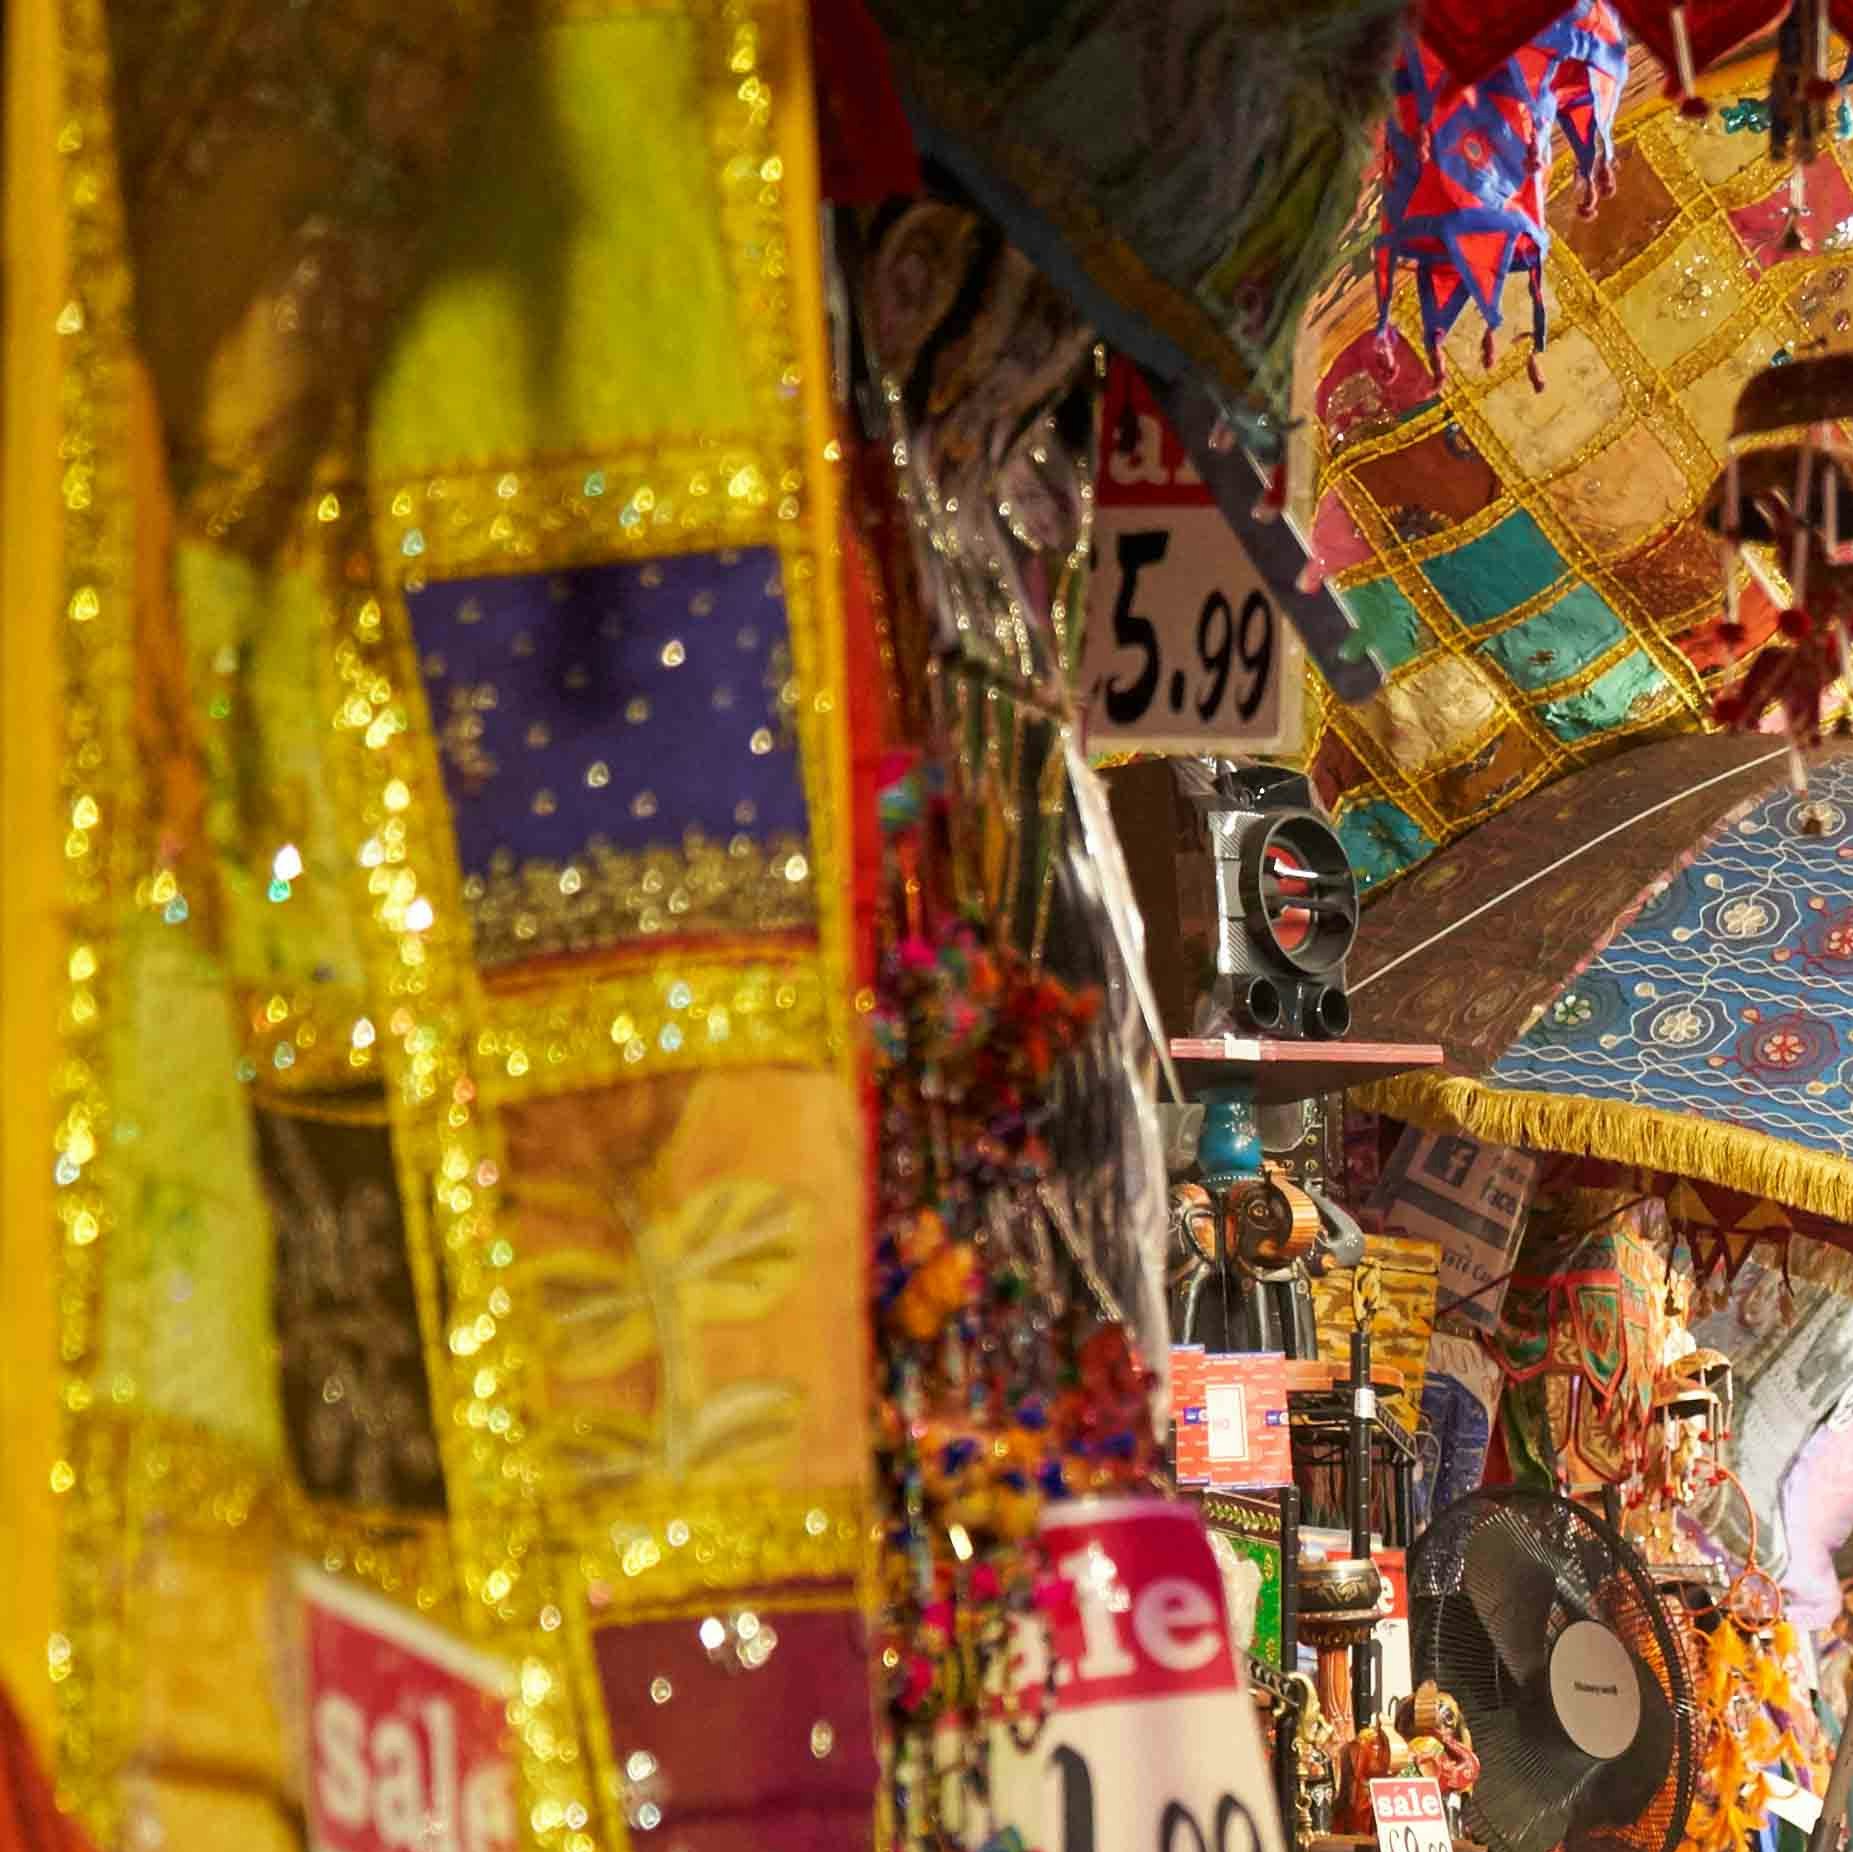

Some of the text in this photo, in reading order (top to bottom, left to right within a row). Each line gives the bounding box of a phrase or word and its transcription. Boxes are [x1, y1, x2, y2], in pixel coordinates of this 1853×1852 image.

[1102, 527, 1274, 726] 5.99
[987, 1541, 1222, 1692] ale
[1376, 1785, 1441, 1821] sale
